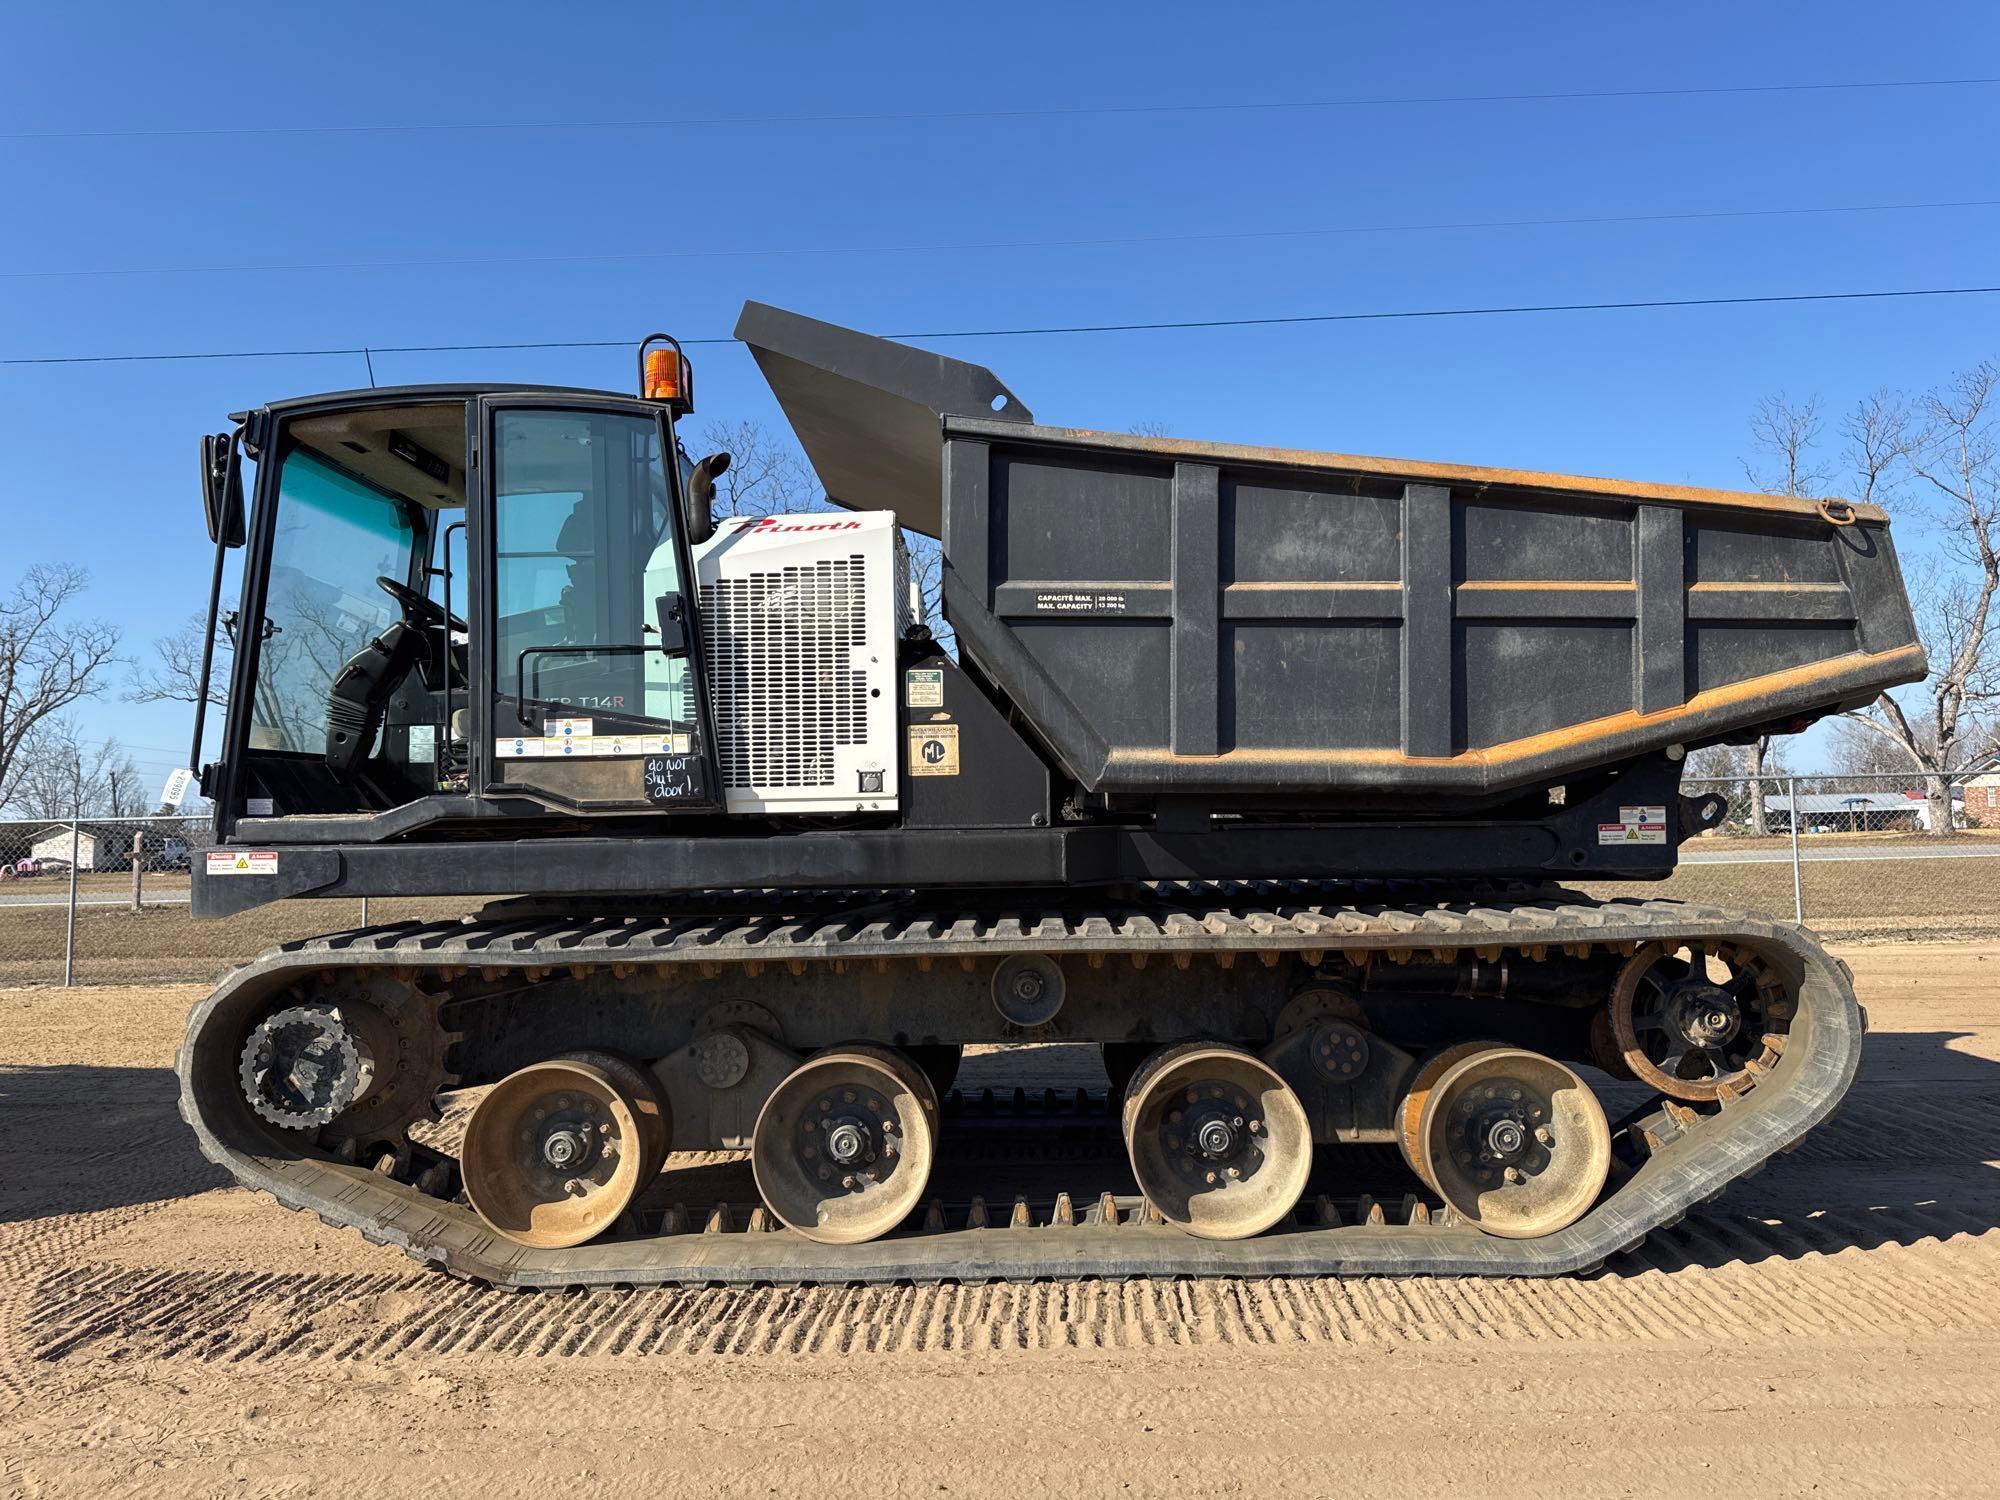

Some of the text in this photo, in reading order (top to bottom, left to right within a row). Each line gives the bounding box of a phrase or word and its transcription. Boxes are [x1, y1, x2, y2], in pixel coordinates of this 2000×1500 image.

[729, 518, 862, 534] Prinoth
[1037, 594, 1074, 602] CAPACITÉ
[579, 696, 625, 709] T14R
[648, 757, 691, 772] do NOT
